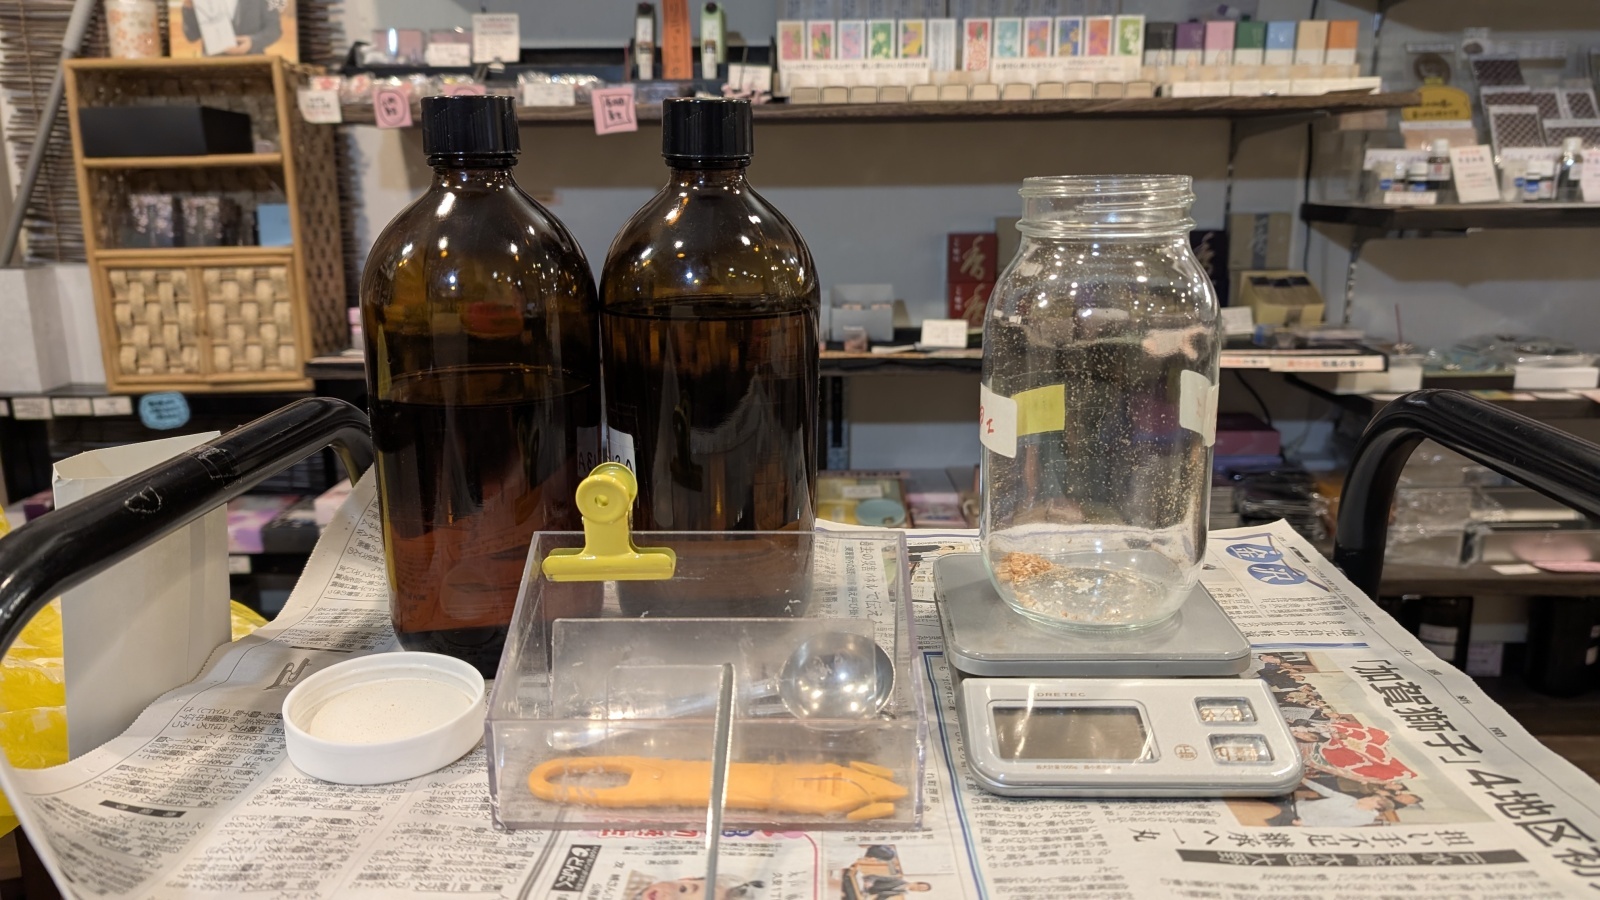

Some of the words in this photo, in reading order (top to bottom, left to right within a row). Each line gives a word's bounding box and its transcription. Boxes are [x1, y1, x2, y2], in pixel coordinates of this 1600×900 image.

[1132, 828, 1294, 847] 継承へ一丸
[1308, 830, 1475, 847] 担い手不足
